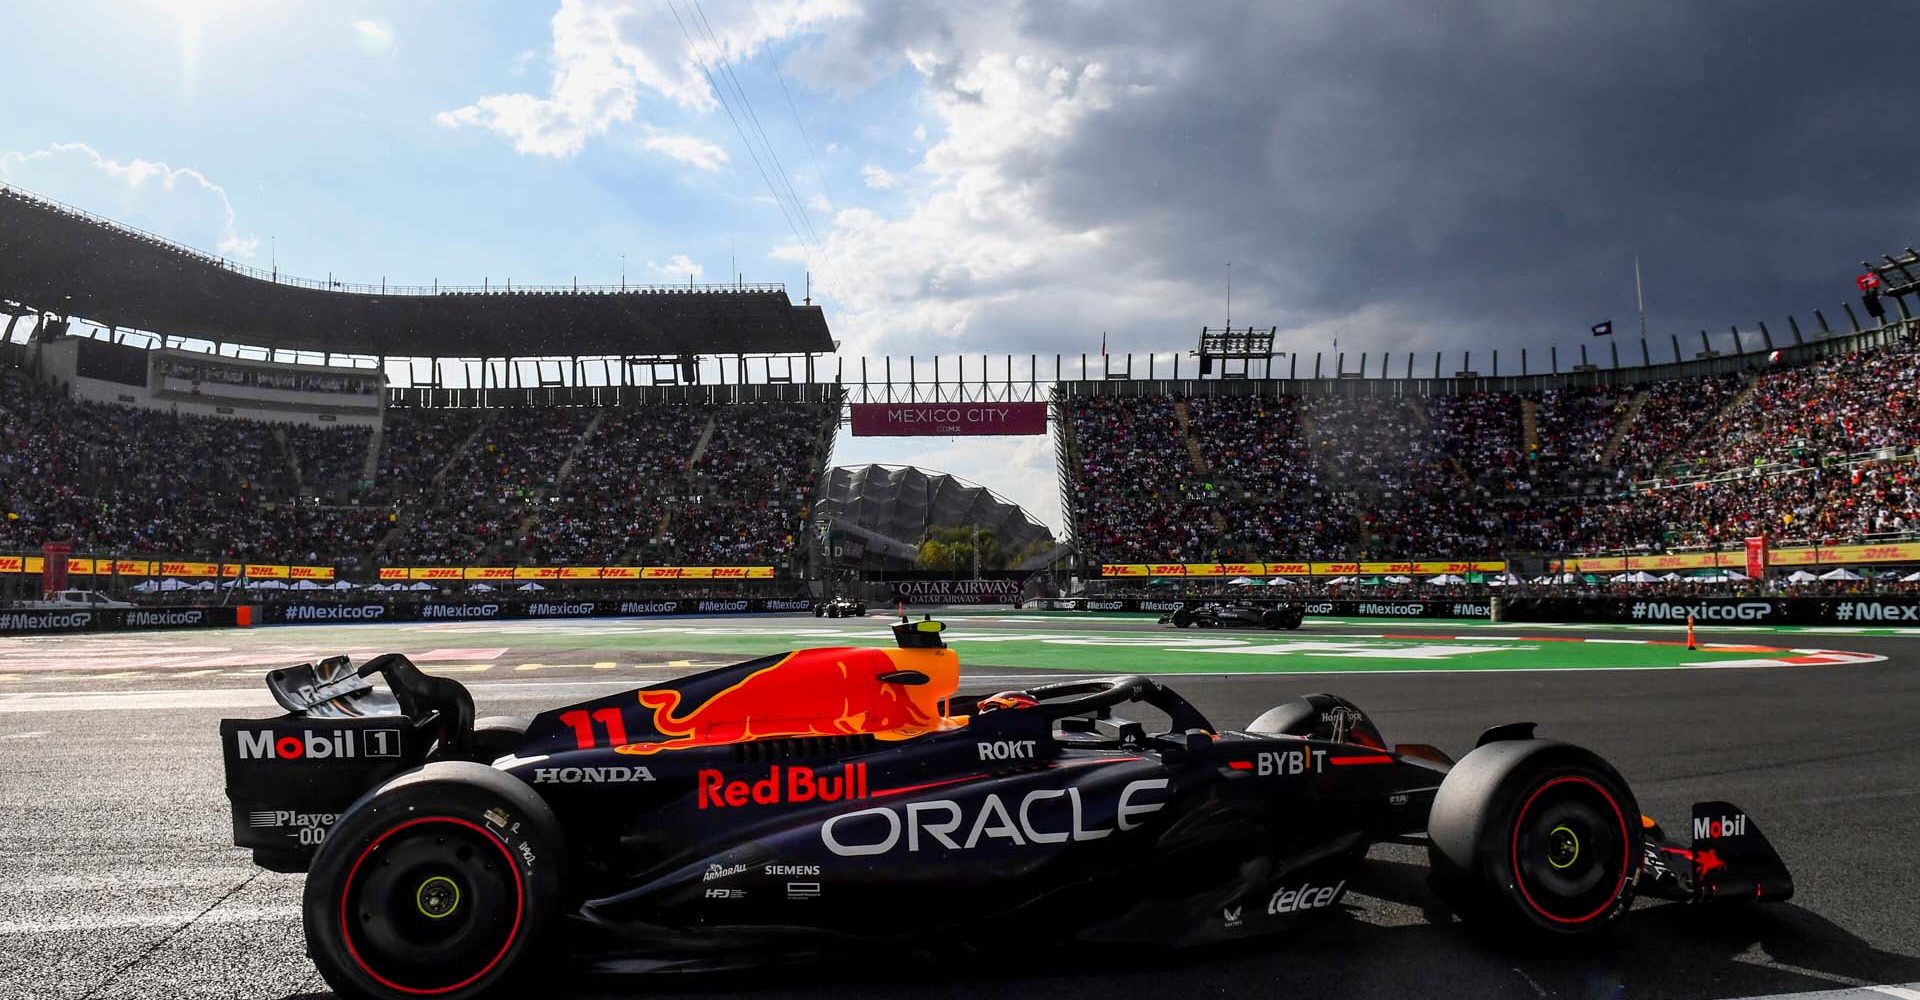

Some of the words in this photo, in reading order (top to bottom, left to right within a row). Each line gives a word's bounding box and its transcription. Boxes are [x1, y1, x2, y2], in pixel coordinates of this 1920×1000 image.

[888, 409, 960, 423] MEXICO
[967, 409, 1009, 422] CITY
[251, 567, 275, 575] DHL
[292, 568, 313, 577] DHL
[540, 569, 571, 577] DHL
[598, 569, 629, 577] DHL
[654, 568, 686, 577] DHL
[712, 568, 744, 576] DHL
[1156, 566, 1185, 574] DHL
[1215, 565, 1246, 574] DHL
[1273, 565, 1305, 573] DHL
[1390, 564, 1421, 572] DHL
[900, 582, 950, 595] QATAR
[954, 581, 1019, 594] AIRWAYS
[767, 600, 810, 610] #MexicoGP
[910, 595, 940, 604] QATAR
[943, 595, 981, 604] AIRWAYS
[999, 595, 1023, 604] QATA
[286, 605, 384, 619] #MexicoGP
[422, 604, 499, 618] #MexicoGP
[529, 602, 595, 615] #MexicoGP
[621, 602, 677, 613] #MexicoGP
[699, 600, 748, 612] #MexicoGP
[1086, 602, 1123, 610] #MexicoGP
[1140, 601, 1185, 611] #MexicoGP
[1358, 604, 1424, 615] #MexicoGP
[1453, 604, 1490, 616] #Mex
[1632, 602, 1772, 620] #MexicoGP
[1836, 602, 1920, 620] #Mex
[1, 613, 91, 629] #MexicoGP
[127, 611, 202, 626] #MexicoGP
[559, 708, 628, 749] 11
[237, 729, 355, 760] Mobil
[374, 731, 388, 755] 1
[977, 740, 1036, 761] ROKT
[1257, 745, 1327, 776] BYBIT
[533, 766, 656, 784] HONDA
[698, 765, 780, 810] Red
[787, 763, 867, 803] Bull
[821, 778, 1169, 856] ORACLE
[1694, 814, 1746, 840] Mobil
[765, 865, 821, 876] SIEMENS
[1267, 879, 1346, 915] telcel
